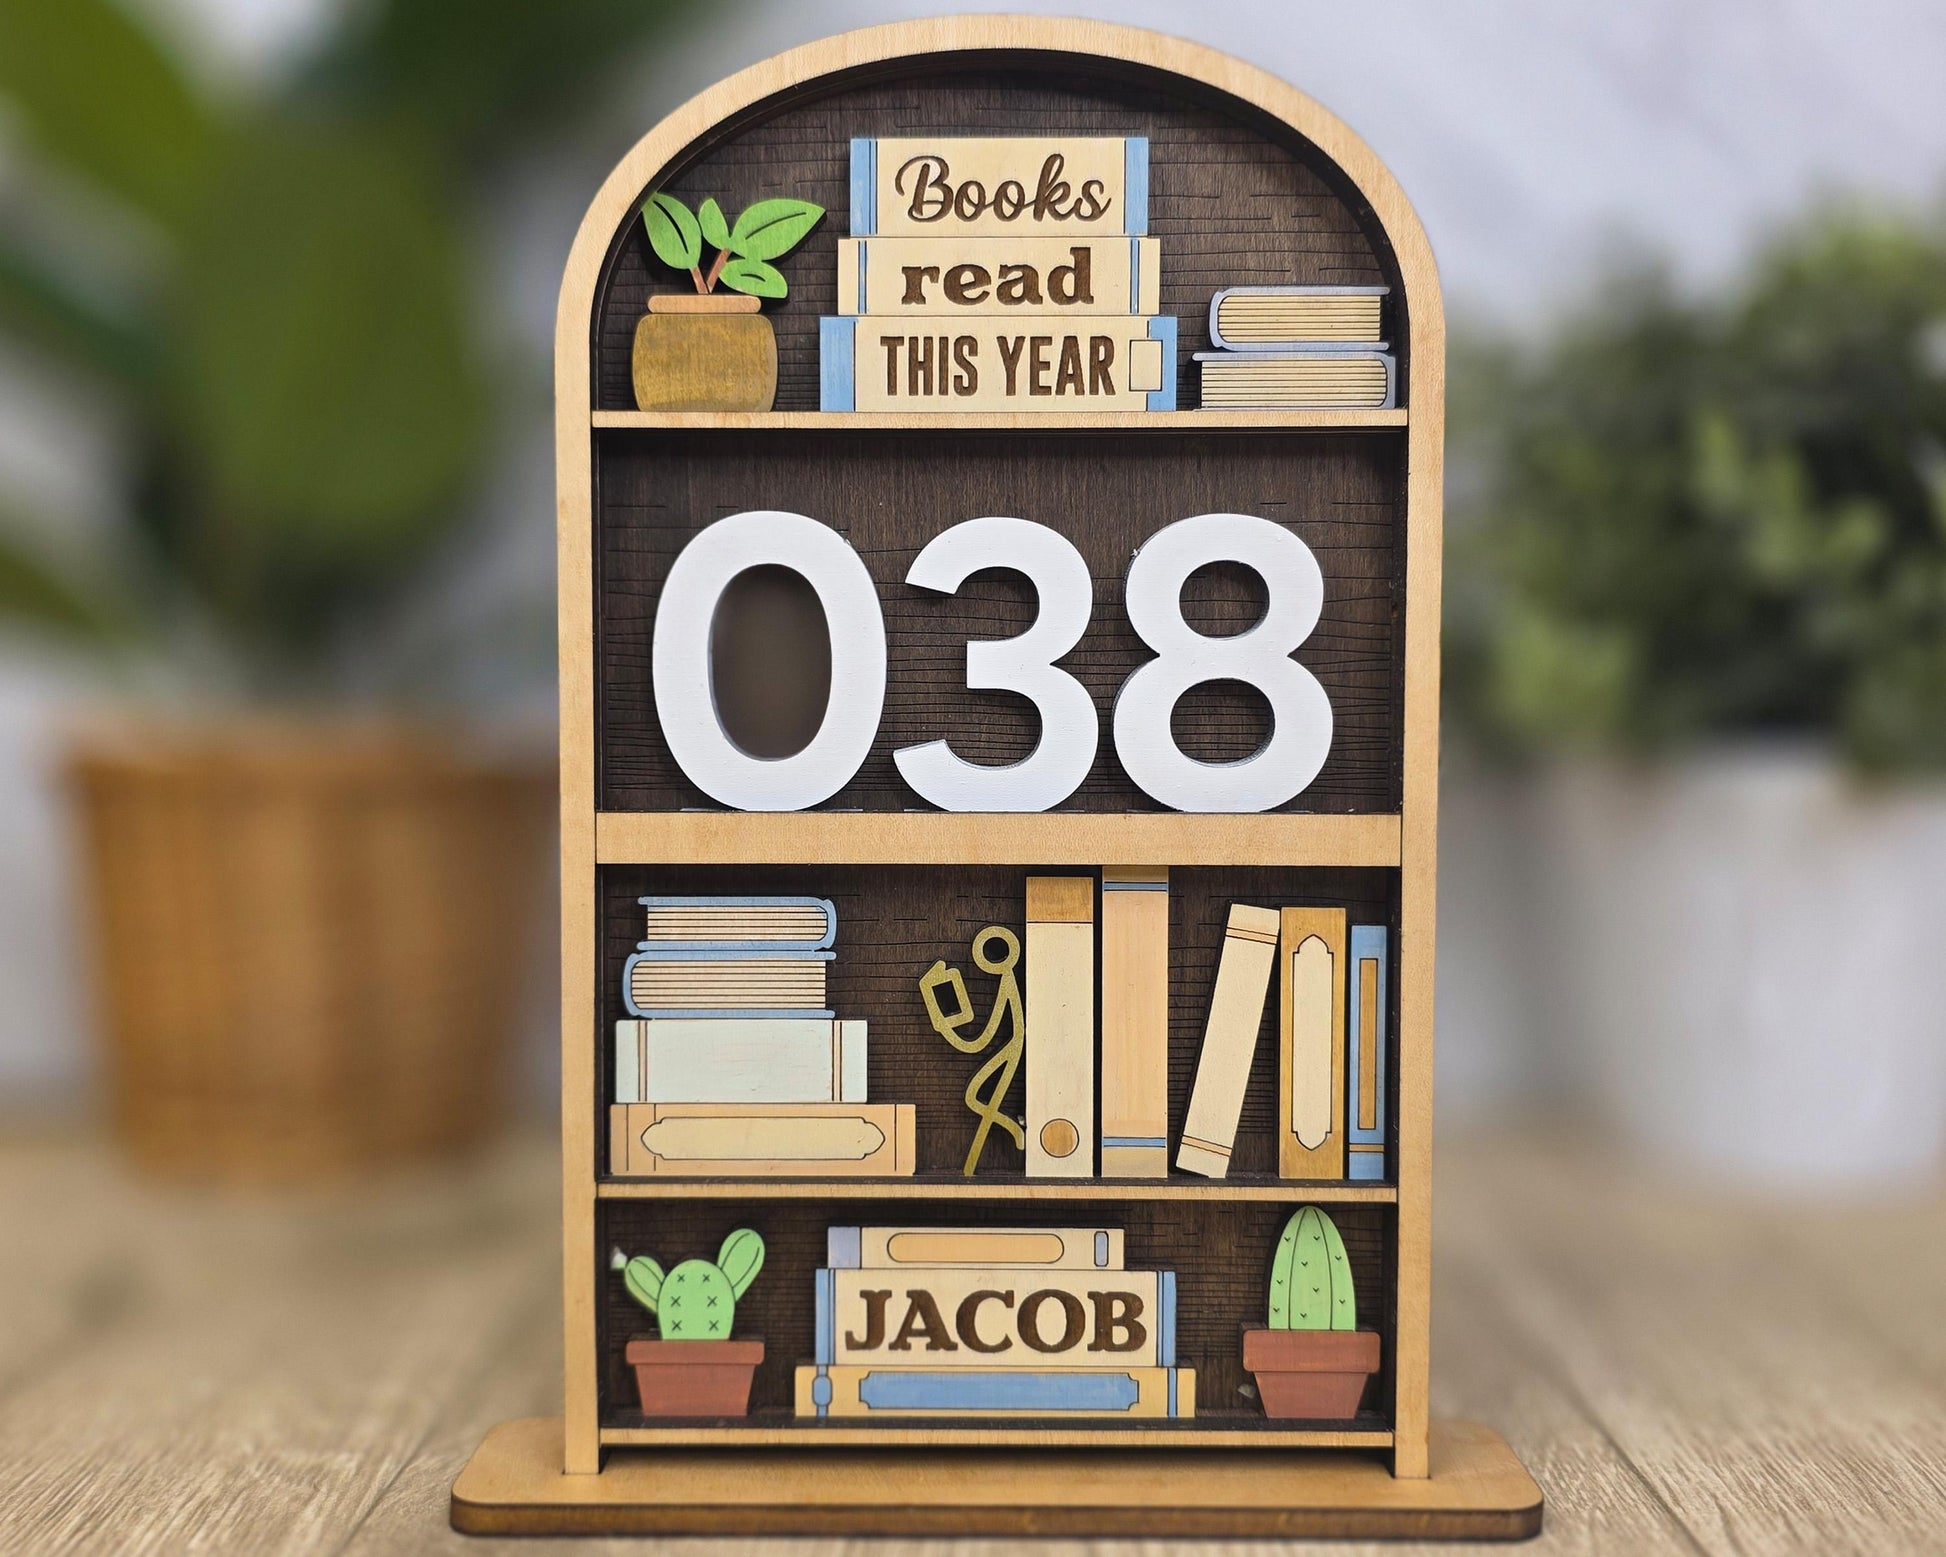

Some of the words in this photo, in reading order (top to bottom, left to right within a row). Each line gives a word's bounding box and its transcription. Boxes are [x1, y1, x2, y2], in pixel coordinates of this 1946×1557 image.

[895, 153, 1112, 223] Books
[901, 247, 1094, 305] read
[880, 335, 979, 397] THIS
[997, 335, 1116, 397] YEAR
[652, 510, 1333, 812] 038
[845, 1288, 1147, 1354] JACOB
